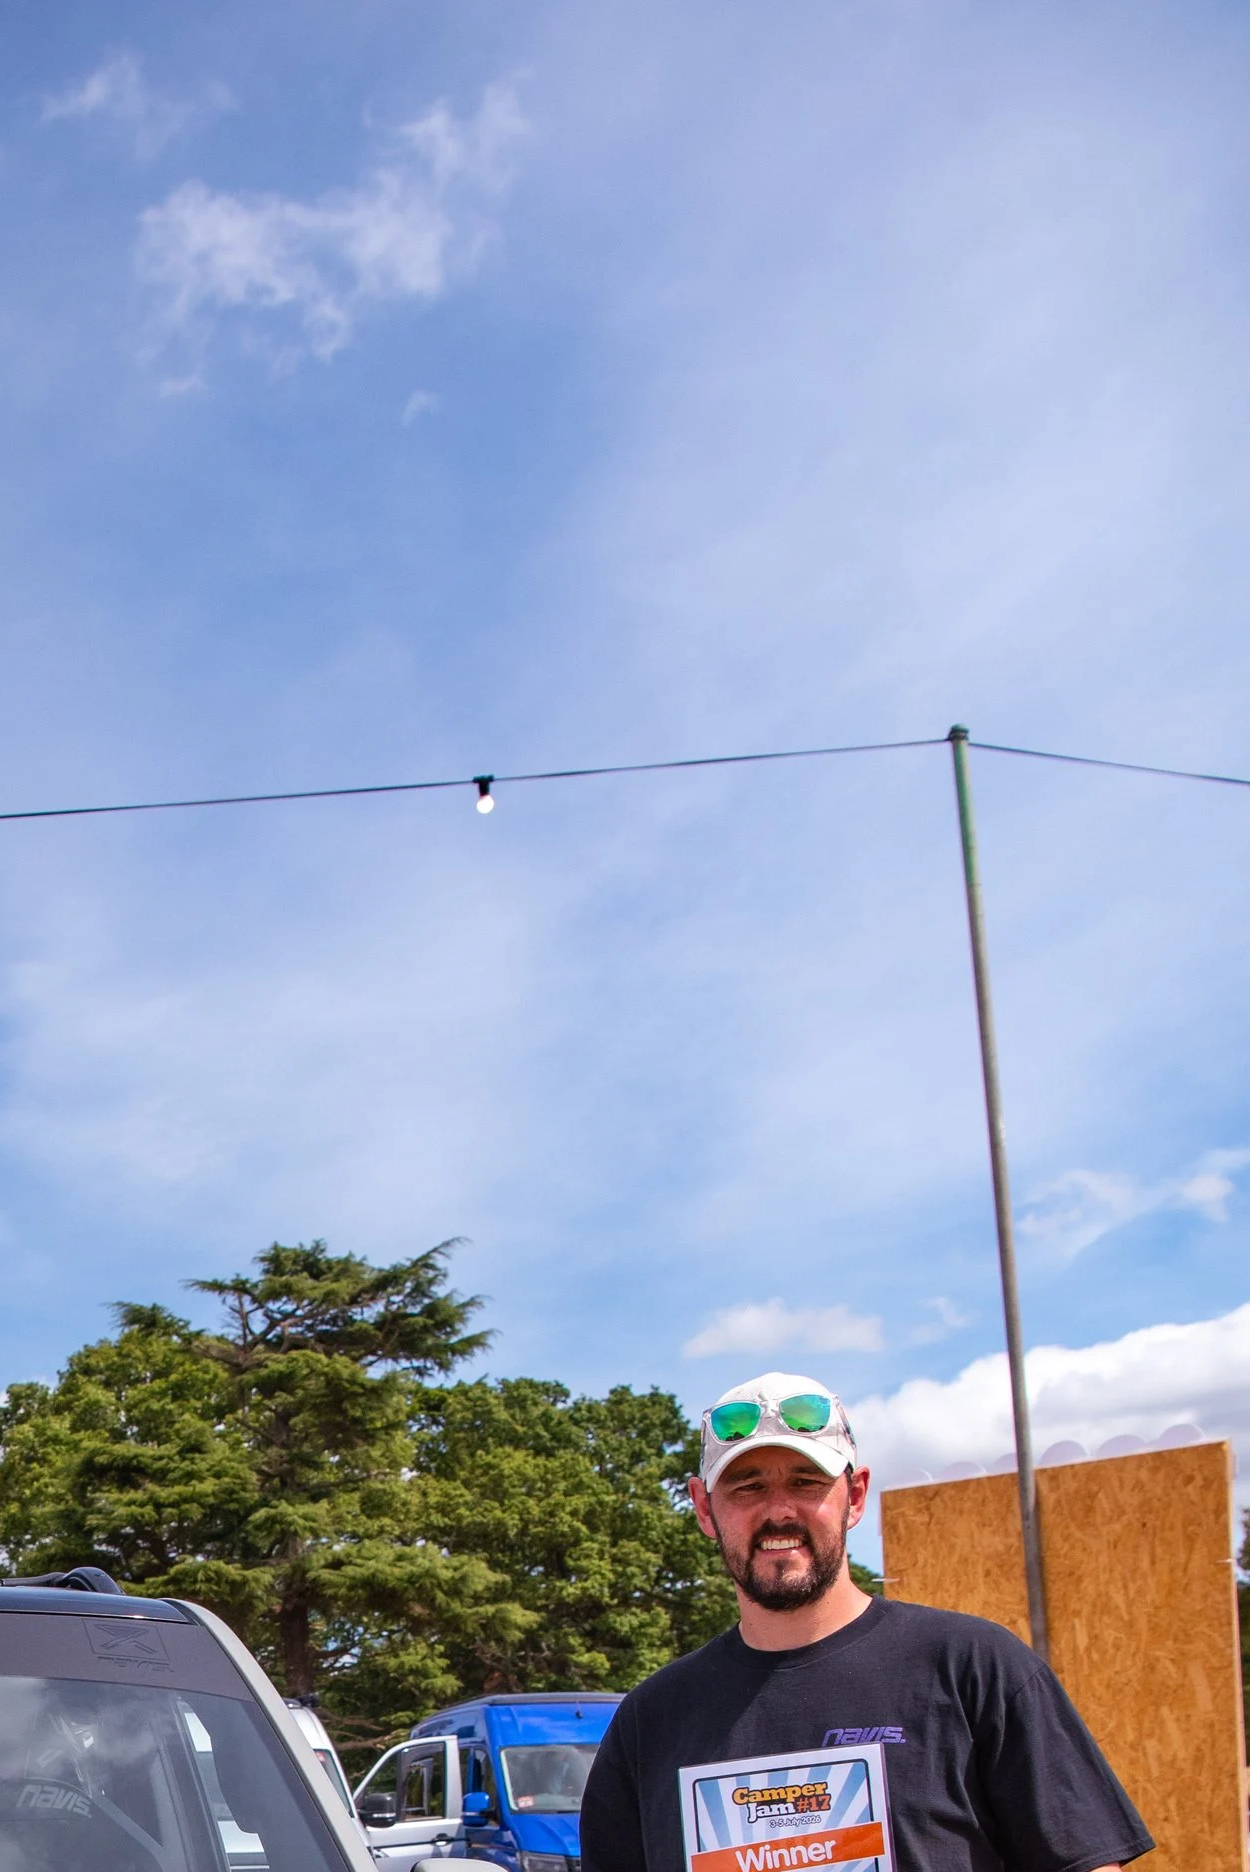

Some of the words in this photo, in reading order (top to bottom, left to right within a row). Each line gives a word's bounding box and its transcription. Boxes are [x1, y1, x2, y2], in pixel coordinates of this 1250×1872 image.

[733, 1783, 827, 1805] Camper
[748, 1802, 796, 1823] Jam
[785, 1816, 800, 1827] July
